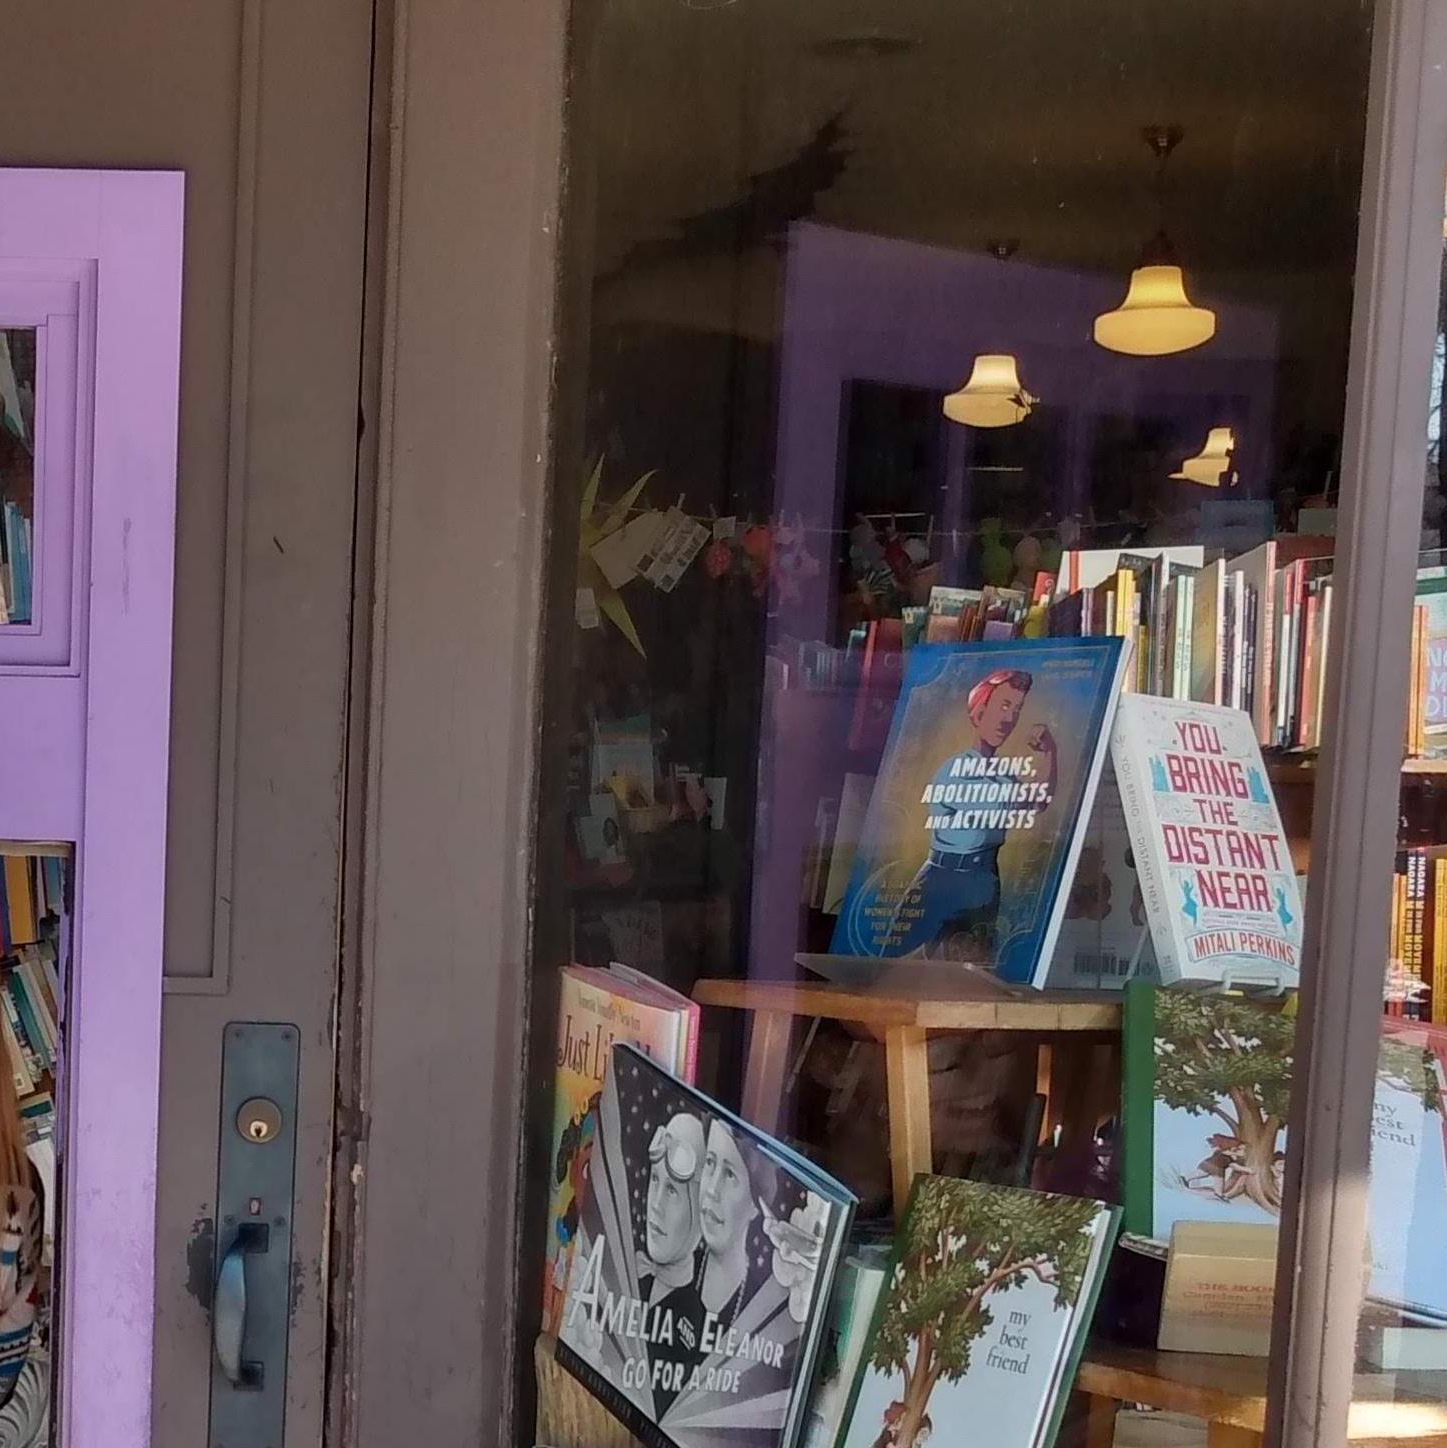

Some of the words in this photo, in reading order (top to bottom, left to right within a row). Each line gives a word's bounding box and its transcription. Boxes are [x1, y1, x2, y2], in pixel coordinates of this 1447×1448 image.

[1175, 720, 1223, 755] YOU
[950, 755, 1038, 778] AMAZONS,
[1166, 753, 1249, 800] BRING
[921, 782, 1053, 805] ABOLITIONISTS,
[951, 808, 1038, 831] ACTIVISTS
[1192, 798, 1239, 827] THE
[1161, 824, 1281, 872] DISTANT
[1195, 870, 1273, 913] NEAR
[1193, 931, 1236, 958] MITALI
[1238, 932, 1296, 966] PERKINS
[557, 1014, 590, 1078] Just
[1375, 1114, 1406, 1131] est
[567, 1233, 675, 1348] AMELIA
[676, 1318, 696, 1351] AND
[699, 1311, 786, 1370] ELEANOR
[1008, 1307, 1032, 1332] my
[999, 1327, 1028, 1350] best
[622, 1355, 647, 1390] GO
[650, 1358, 682, 1392] FOR
[686, 1363, 702, 1392] A
[702, 1369, 741, 1395] RIDE
[985, 1345, 1031, 1375] friend
